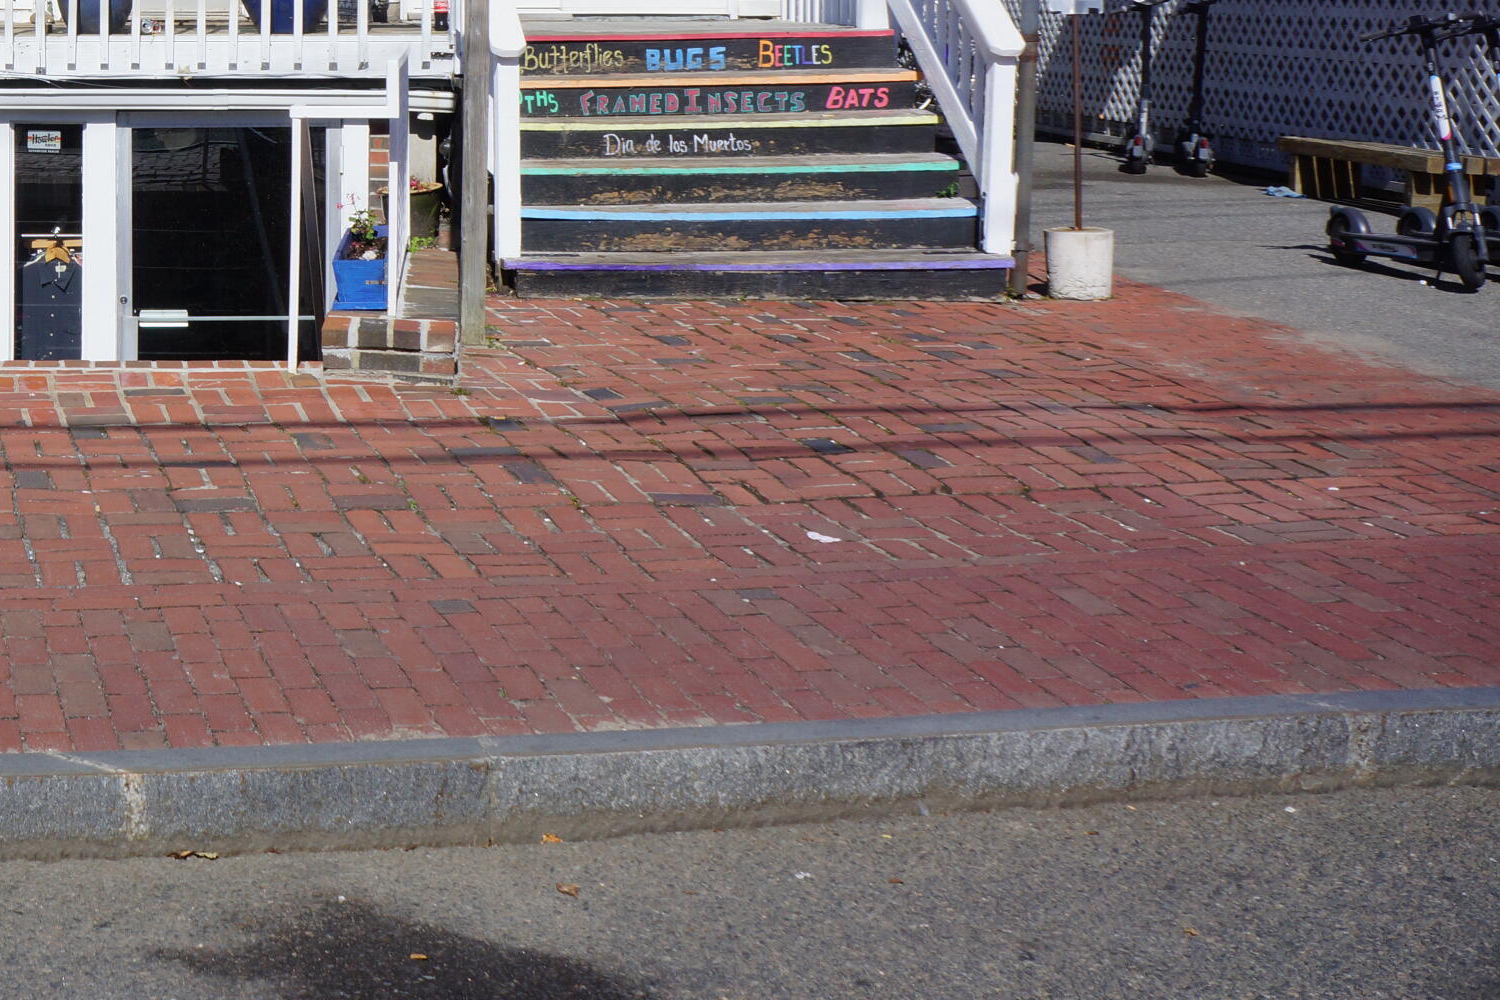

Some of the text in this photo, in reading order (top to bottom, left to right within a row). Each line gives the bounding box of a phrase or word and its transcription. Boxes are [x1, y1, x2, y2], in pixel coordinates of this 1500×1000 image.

[520, 38, 833, 75] Butterflies BUGS BEETLES
[519, 86, 890, 116] THS FRAMED INSECTS BATS
[602, 132, 752, 156] Dia de los Muertos
